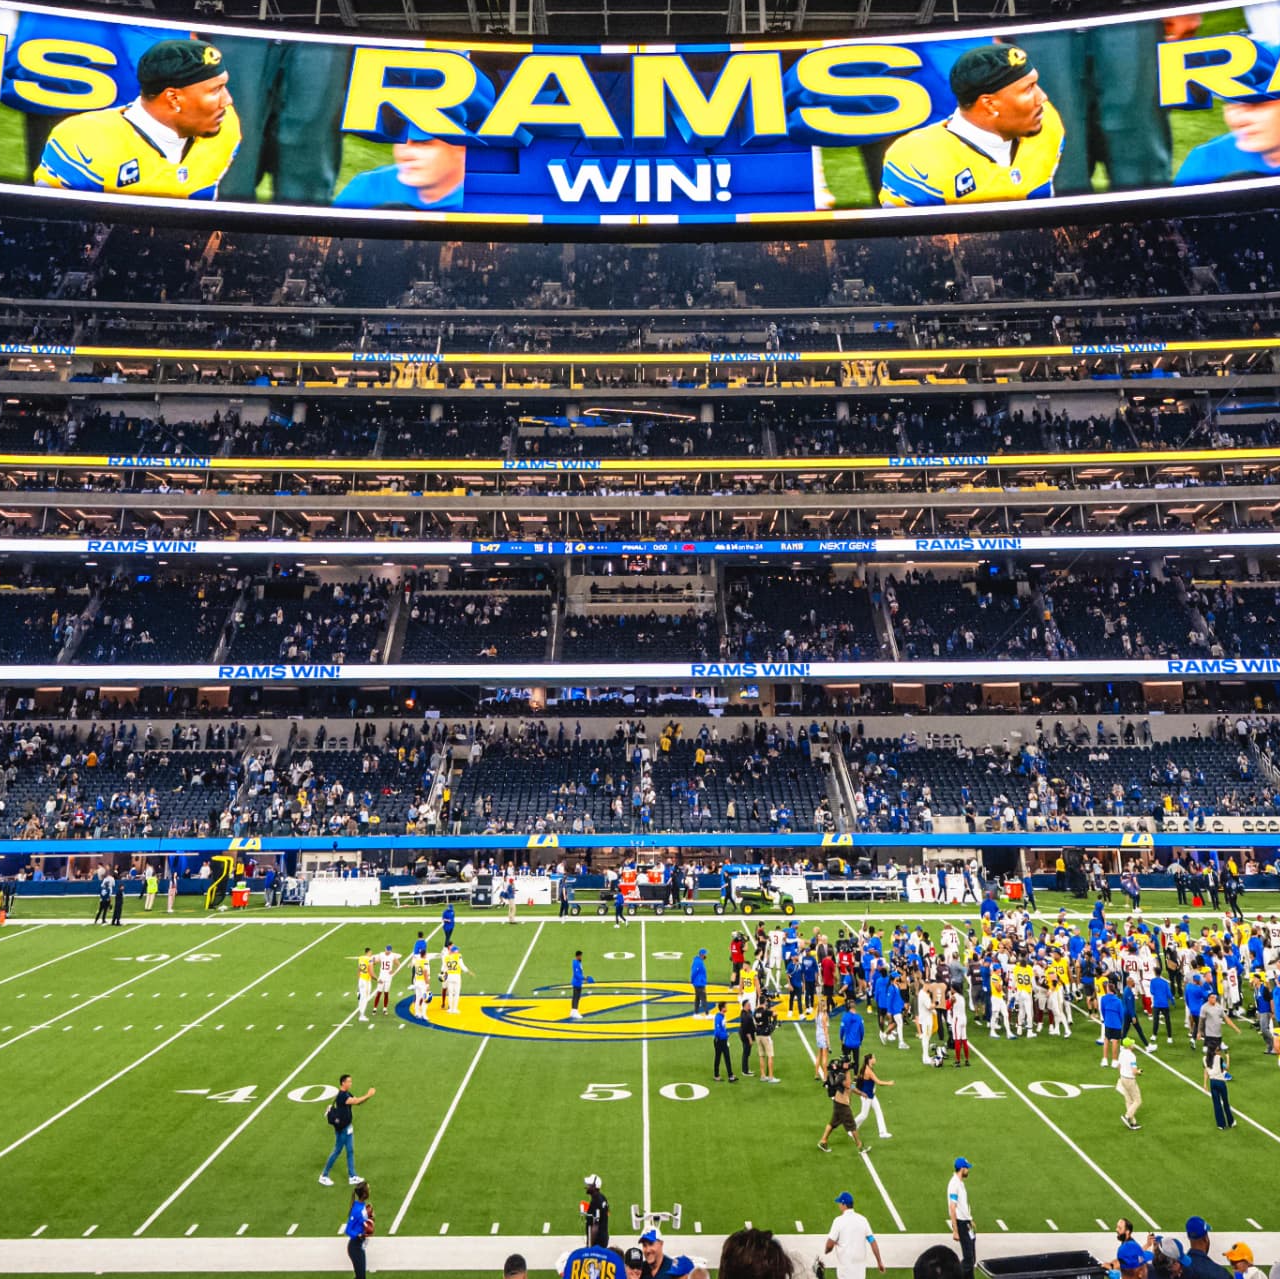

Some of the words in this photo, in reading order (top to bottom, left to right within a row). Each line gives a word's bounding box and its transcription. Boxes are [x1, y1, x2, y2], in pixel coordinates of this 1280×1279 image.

[341, 45, 933, 139] RAMS
[547, 163, 732, 203] WIN!
[109, 457, 164, 467] RAMS
[171, 458, 209, 468] WIN!
[504, 460, 556, 470] RAMS
[562, 461, 599, 469] WIN!
[890, 457, 944, 466] RAMS
[949, 456, 987, 465] WIN!
[88, 540, 148, 554] RAMS
[153, 541, 196, 553] WIN!
[820, 542, 846, 551] NEXT
[849, 542, 869, 551] GEN
[916, 538, 974, 552] RAMS
[978, 538, 1022, 551] WIN!
[219, 664, 288, 680] RAMS
[291, 665, 340, 679] WIN!
[691, 662, 757, 678] RAMS
[761, 664, 810, 677] WIN!
[1168, 659, 1238, 674] RAMS
[1017, 974, 1031, 984] 69
[207, 1084, 339, 1104] 40
[579, 1081, 711, 1101] 50
[953, 1080, 1084, 1100] 40
